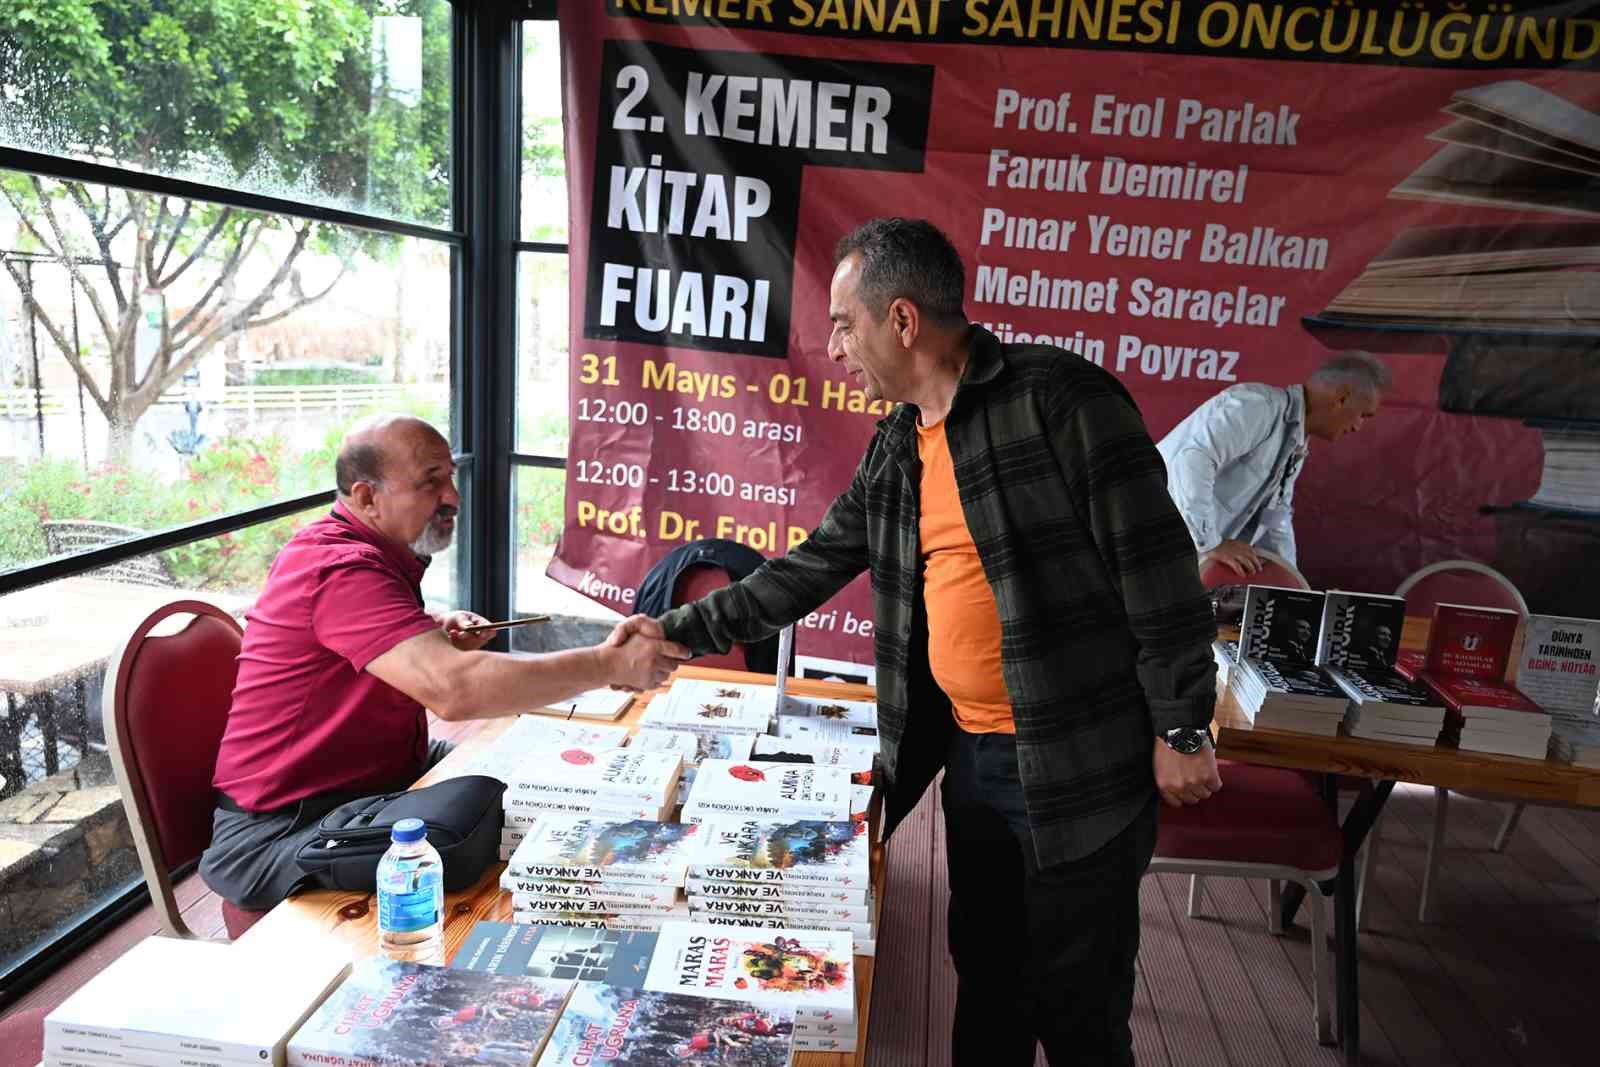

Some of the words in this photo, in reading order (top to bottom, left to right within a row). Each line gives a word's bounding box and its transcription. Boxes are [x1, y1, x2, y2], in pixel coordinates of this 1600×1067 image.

[789, 0, 944, 35] SANAT
[612, 64, 665, 133] 2.
[684, 71, 892, 155] KEMER
[993, 89, 1077, 134] Prof.
[1090, 95, 1163, 138] Erol
[1176, 100, 1301, 147] Parlak
[987, 149, 1092, 193] Faruk
[1100, 155, 1249, 204] Demirel
[607, 154, 772, 243] KİTAP
[980, 207, 1077, 253] Pınar
[1087, 215, 1191, 263] Yener
[1200, 223, 1330, 271] Balkan
[600, 262, 771, 343] FUARI
[974, 265, 1119, 314] Mehmet
[1127, 279, 1287, 328] Saraçlar
[1116, 334, 1240, 382] Poyraz
[579, 354, 620, 386] 31
[641, 360, 736, 402] Mayıs
[768, 374, 809, 406] 01
[577, 398, 648, 426] 12:00
[672, 408, 736, 436] 18:00
[742, 417, 801, 443] arası
[576, 461, 643, 488] 12:00
[667, 470, 735, 497] 13:00
[740, 480, 796, 506] arası
[577, 501, 647, 539] Prof.
[659, 511, 704, 541] Dr.
[517, 882, 571, 896] ANKARA
[526, 865, 580, 878] ANKARA
[585, 867, 602, 878] VE
[706, 868, 761, 880] ANKARA
[766, 870, 784, 881] VE
[529, 900, 584, 912] ANKARA
[575, 886, 592, 897] VE
[590, 901, 607, 911] VE
[702, 884, 758, 897] ANKARA
[706, 901, 762, 913] ANKARA
[762, 887, 780, 897] VE
[766, 902, 784, 914] VE
